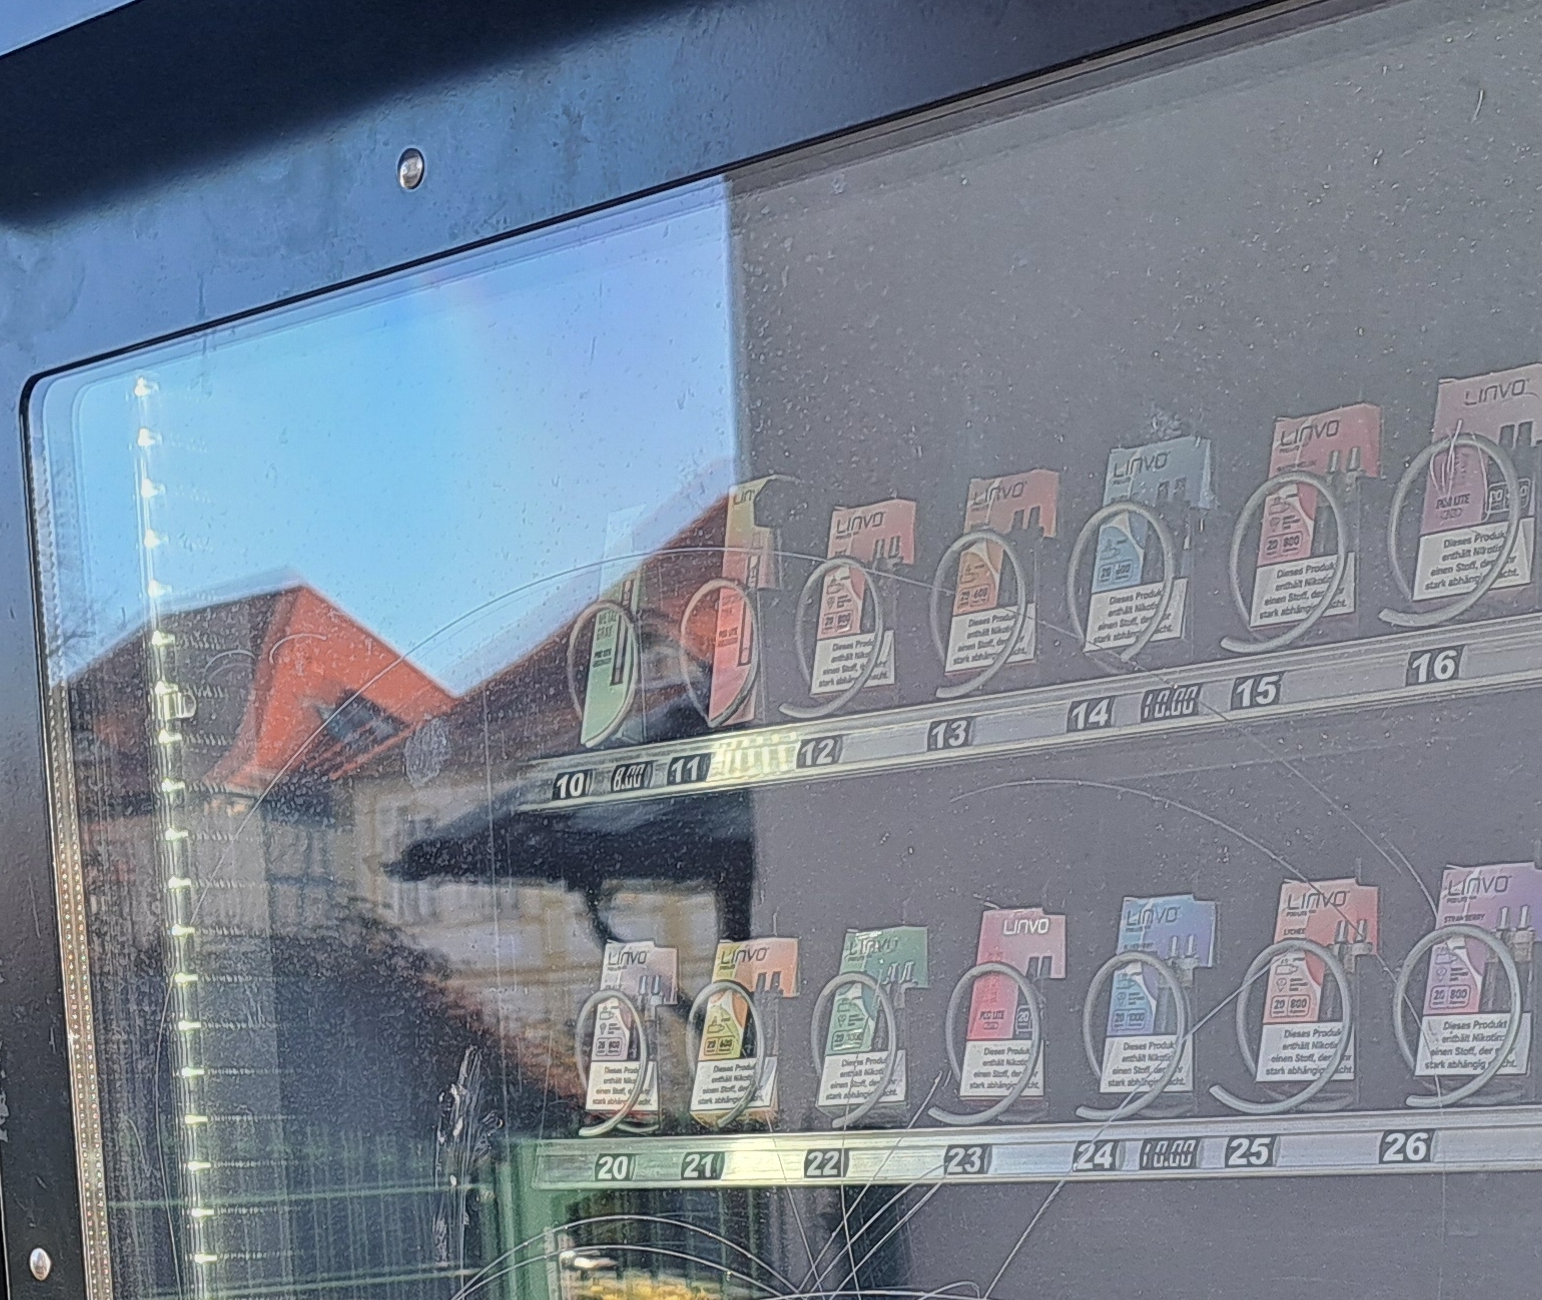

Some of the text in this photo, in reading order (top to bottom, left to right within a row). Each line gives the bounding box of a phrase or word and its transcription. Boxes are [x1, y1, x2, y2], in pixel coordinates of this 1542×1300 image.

[1411, 650, 1456, 682] 16
[1142, 686, 1198, 720] 10.00
[1236, 676, 1278, 707] 15
[1072, 702, 1110, 729] 14
[932, 721, 967, 749] 13
[800, 739, 834, 765] 12
[671, 758, 700, 782] 11
[557, 774, 584, 798] 10
[1075, 1142, 1114, 1170] 24
[1142, 1140, 1196, 1168] 10.00
[1227, 1137, 1270, 1165] 25
[1382, 1132, 1428, 1161] 26
[598, 1155, 628, 1181] 20
[684, 1153, 716, 1178] 21
[807, 1150, 841, 1176] 22
[948, 1147, 985, 1174] 23
